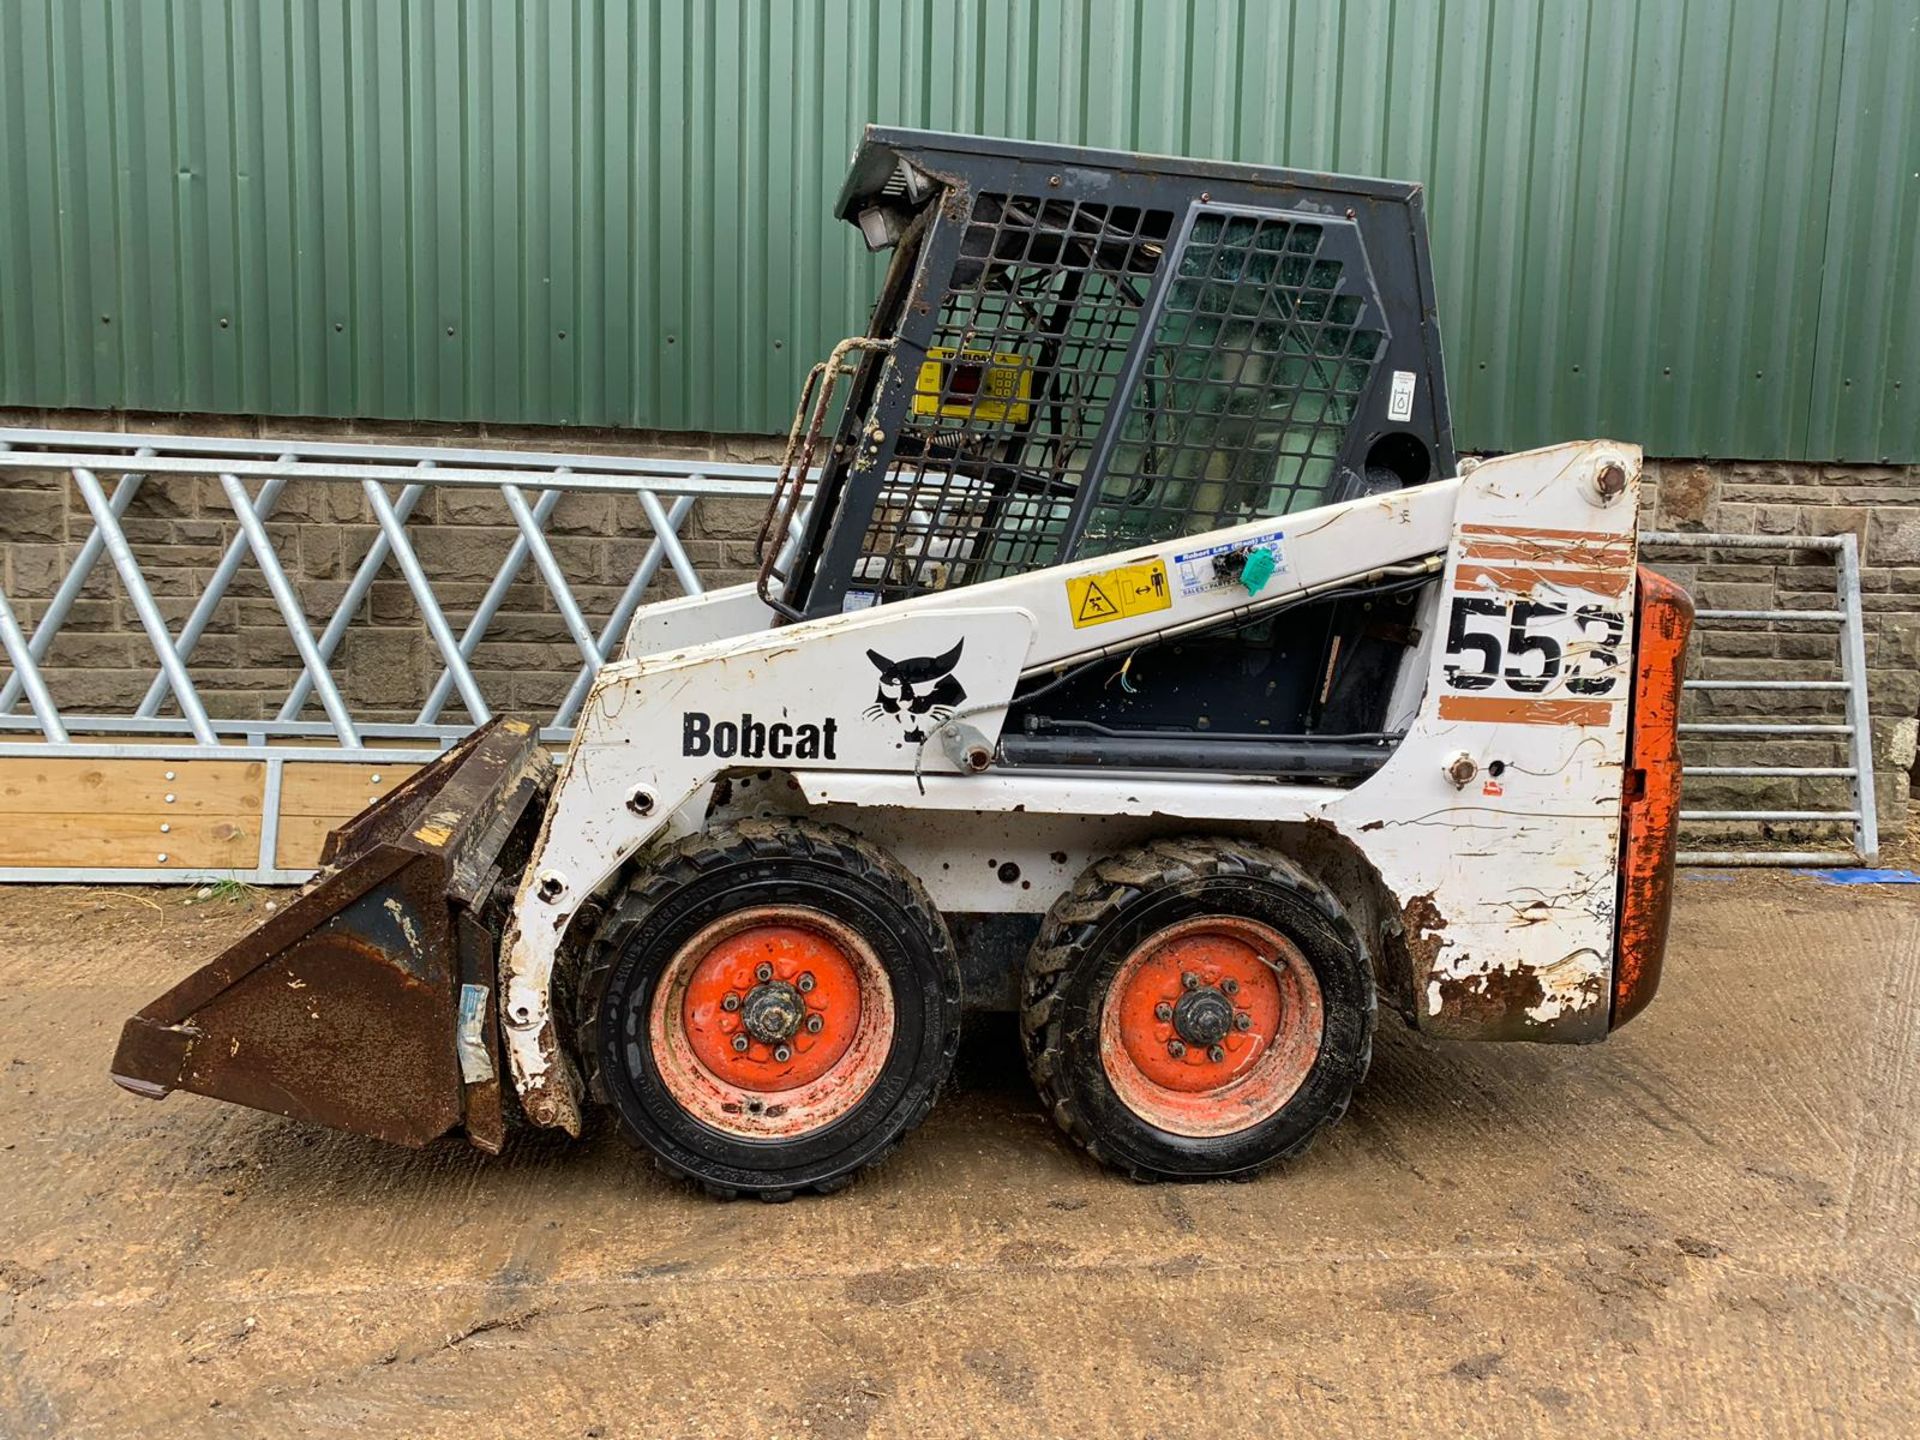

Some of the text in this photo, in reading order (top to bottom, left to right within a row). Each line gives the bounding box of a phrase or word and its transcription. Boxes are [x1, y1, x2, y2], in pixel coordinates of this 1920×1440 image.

[1182, 549, 1210, 562] Robert
[1213, 545, 1229, 555] Lee
[1261, 534, 1275, 544] Ltd
[1443, 596, 1625, 696] 553
[682, 711, 838, 760] Bobcat
